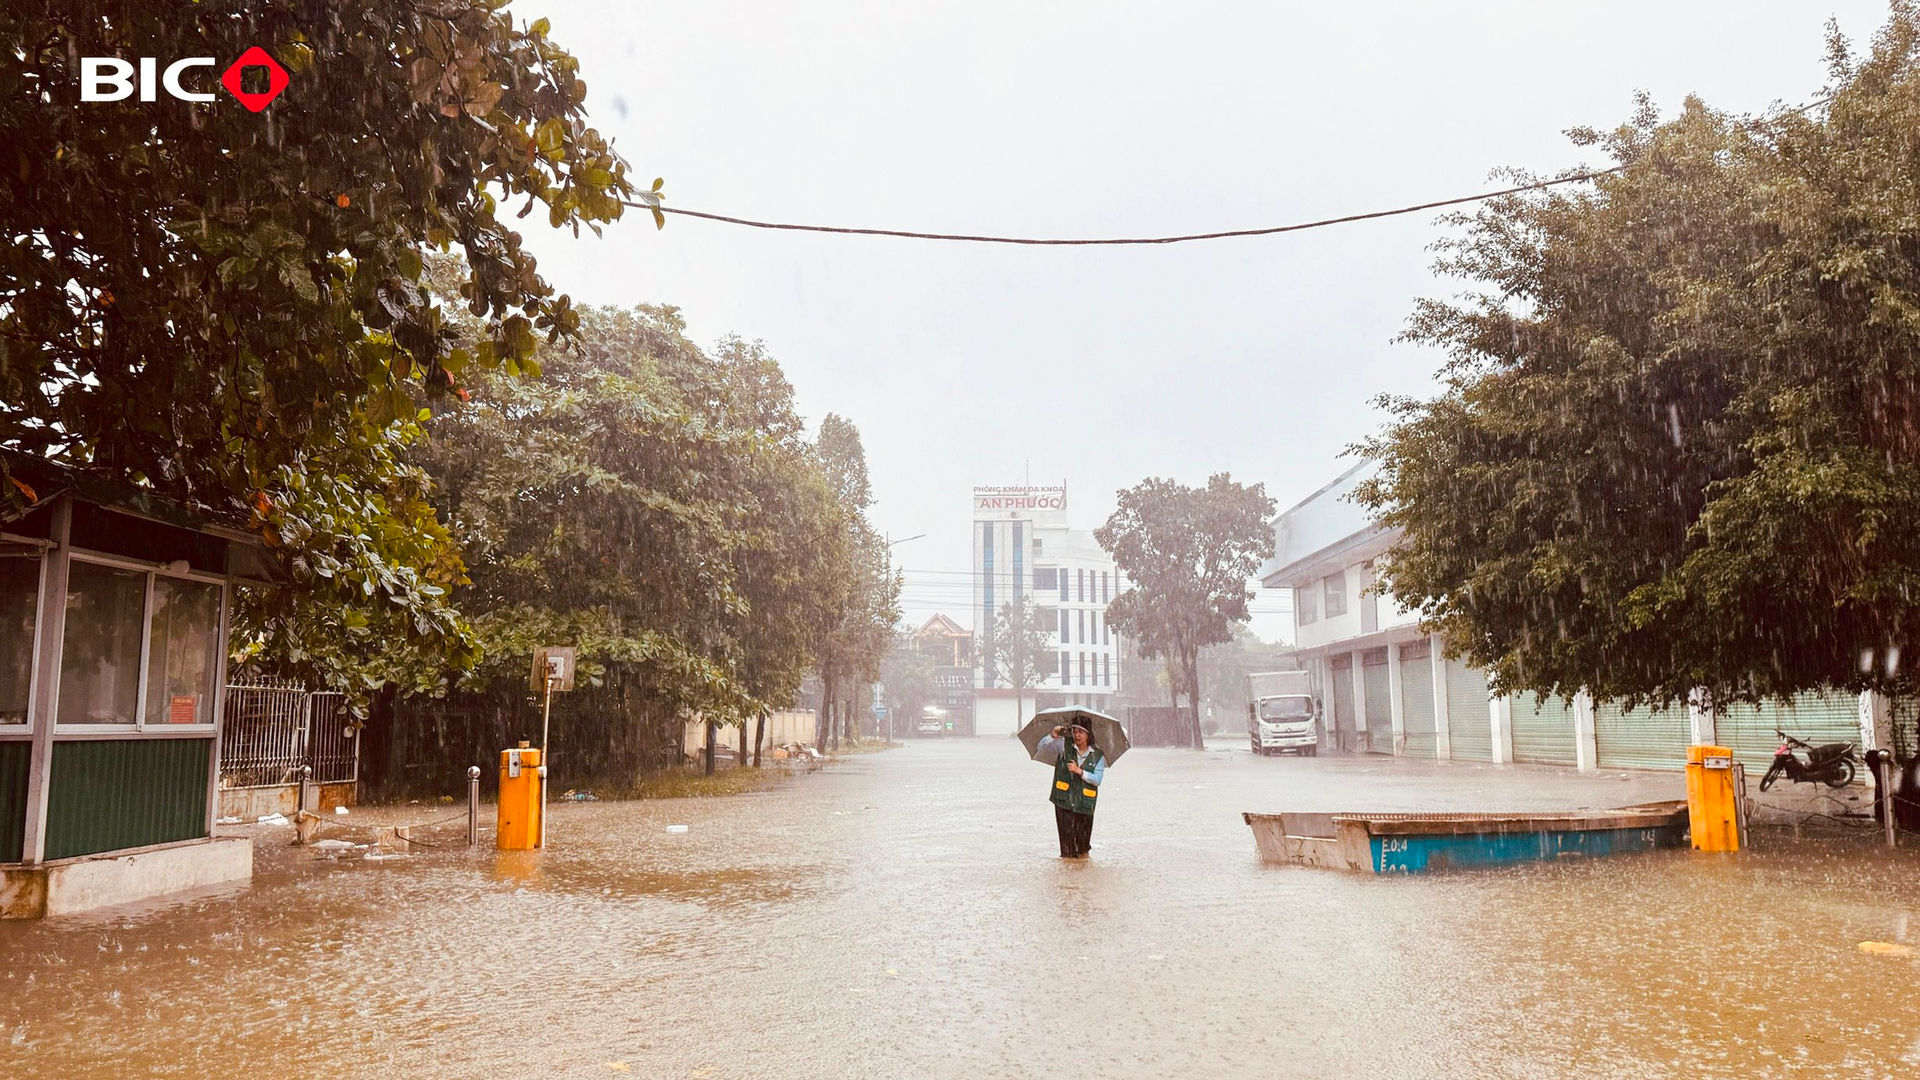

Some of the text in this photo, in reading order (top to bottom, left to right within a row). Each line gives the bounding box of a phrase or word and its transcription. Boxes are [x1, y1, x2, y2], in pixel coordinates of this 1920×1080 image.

[1003, 484, 1027, 493] KHÁM
[980, 495, 1061, 509] AN PHƯỚC
